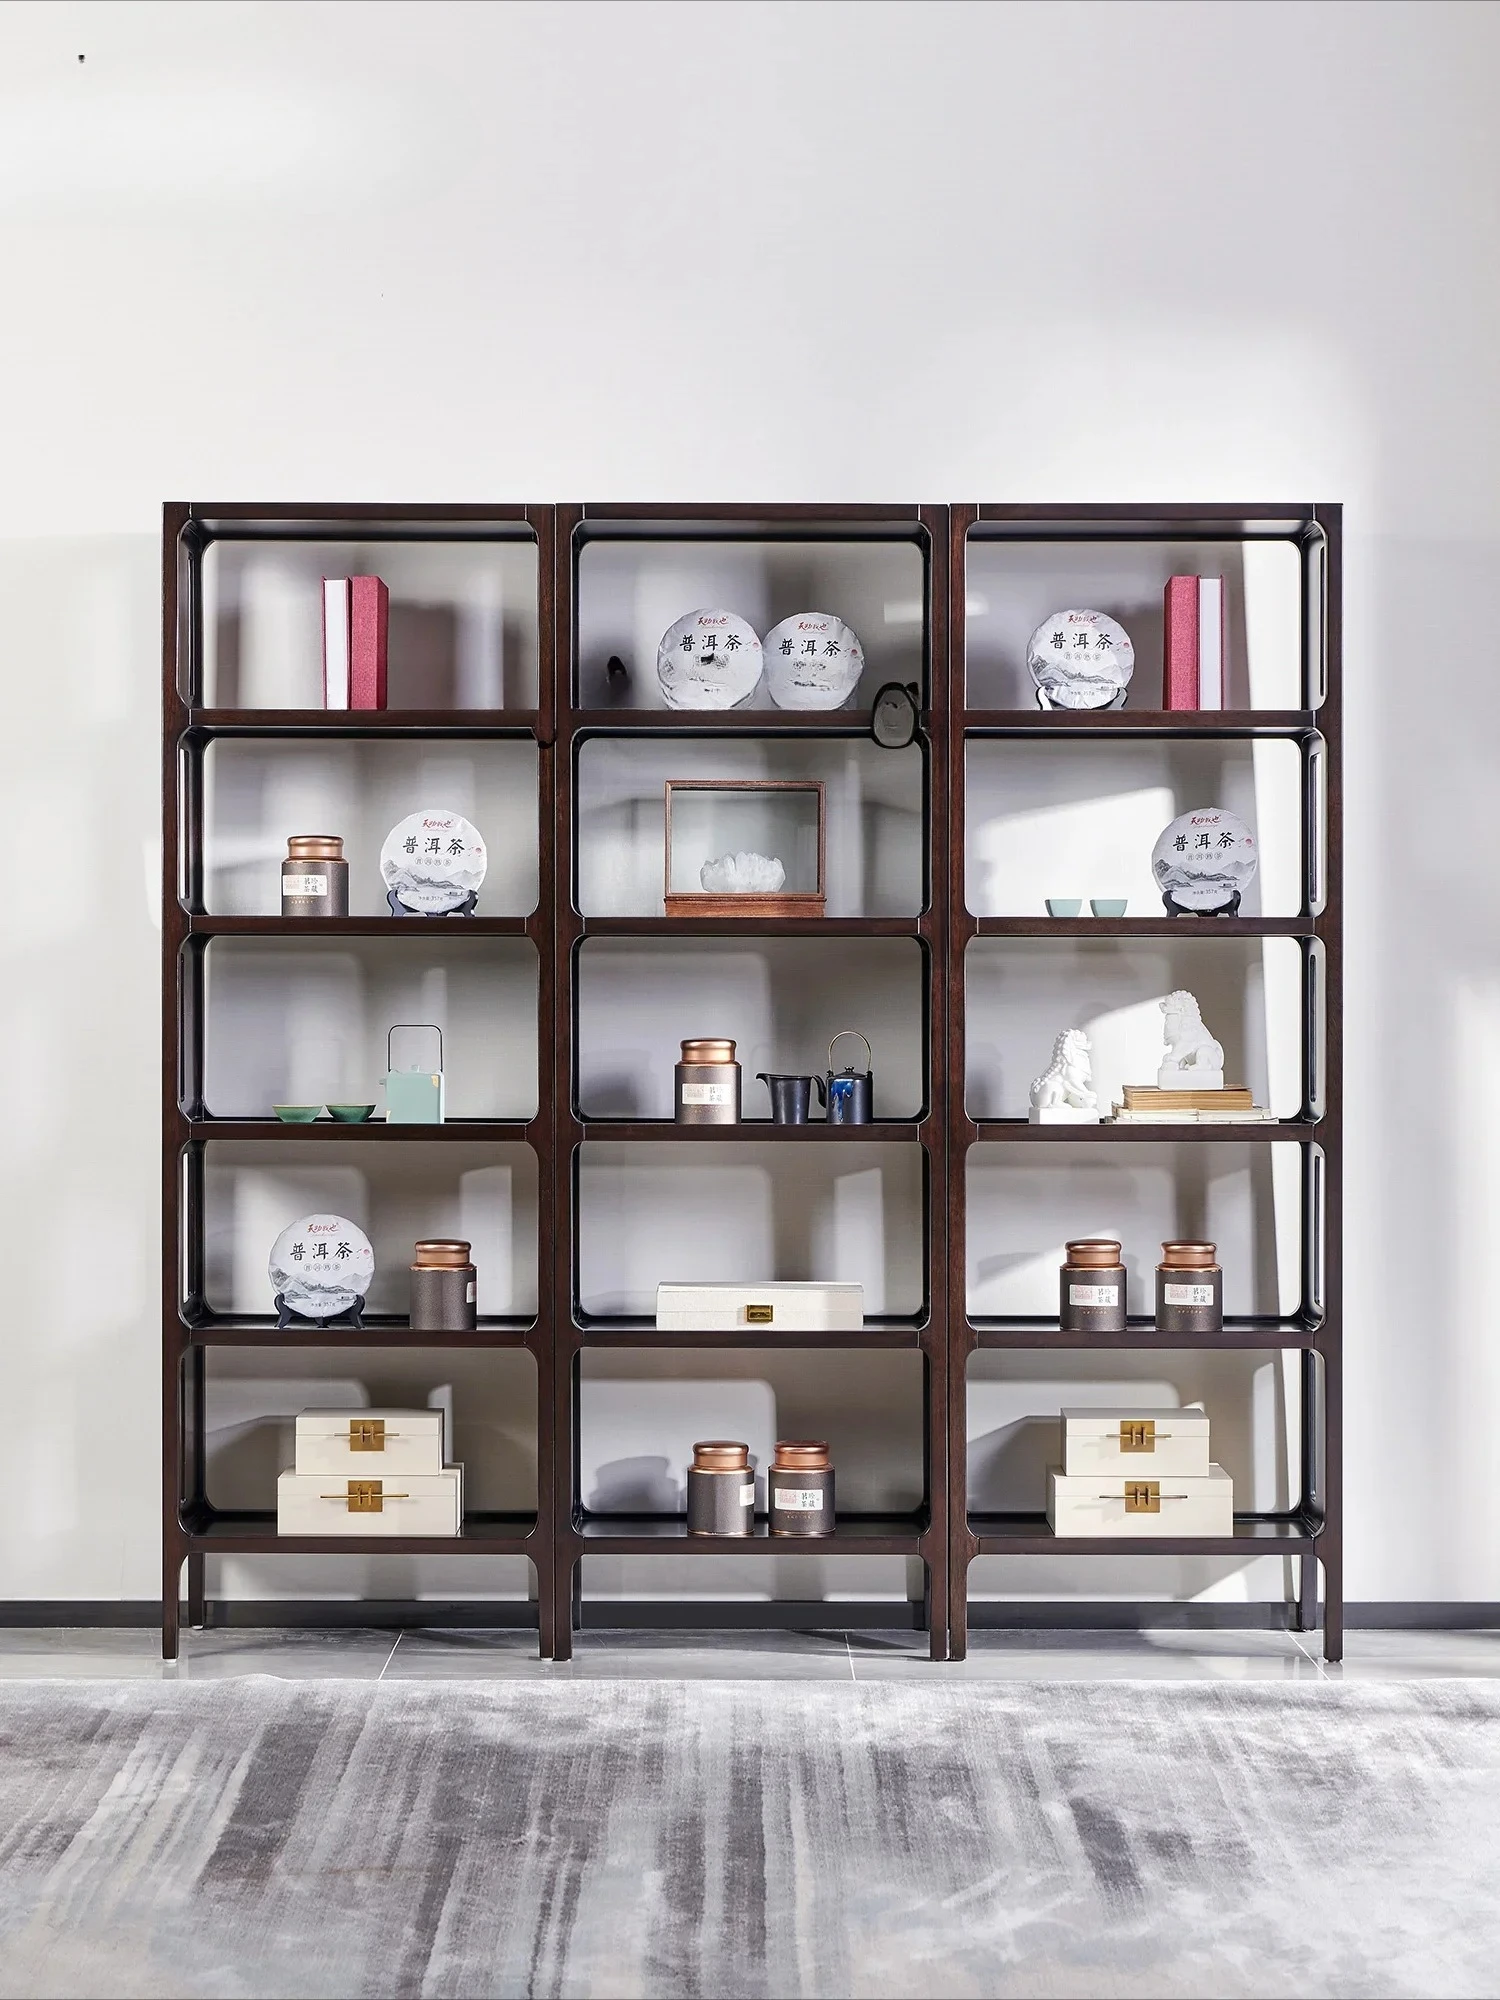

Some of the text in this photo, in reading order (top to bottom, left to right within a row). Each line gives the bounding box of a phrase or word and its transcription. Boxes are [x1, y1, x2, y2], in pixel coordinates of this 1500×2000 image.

[680, 633, 742, 652] 普洱茶
[778, 638, 841, 657] 普洱茶
[1050, 632, 1113, 650] 普洱茶
[403, 836, 465, 855] 普洱茶
[1172, 832, 1235, 851] 普洱茶
[290, 1242, 353, 1261] 普洱茶
